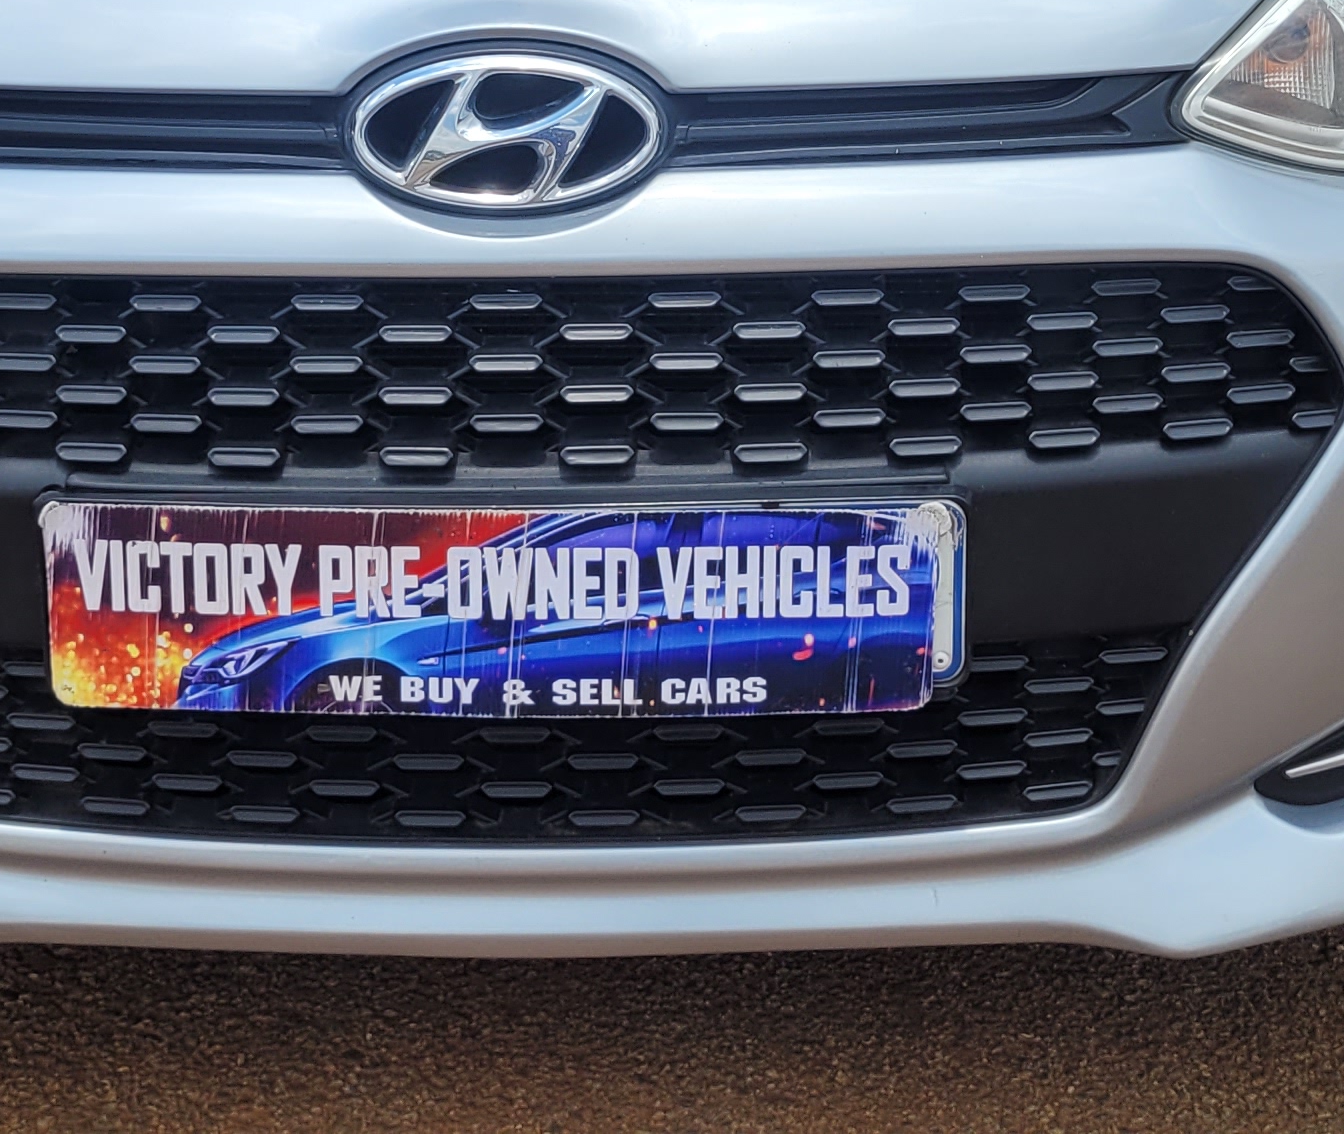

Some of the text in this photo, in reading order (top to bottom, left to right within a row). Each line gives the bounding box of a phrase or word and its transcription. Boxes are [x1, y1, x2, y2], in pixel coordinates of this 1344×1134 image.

[74, 539, 911, 621] VICTORY PRE-OWNED VEHICLES
[328, 675, 768, 706] WE BUY & SELL CARS
